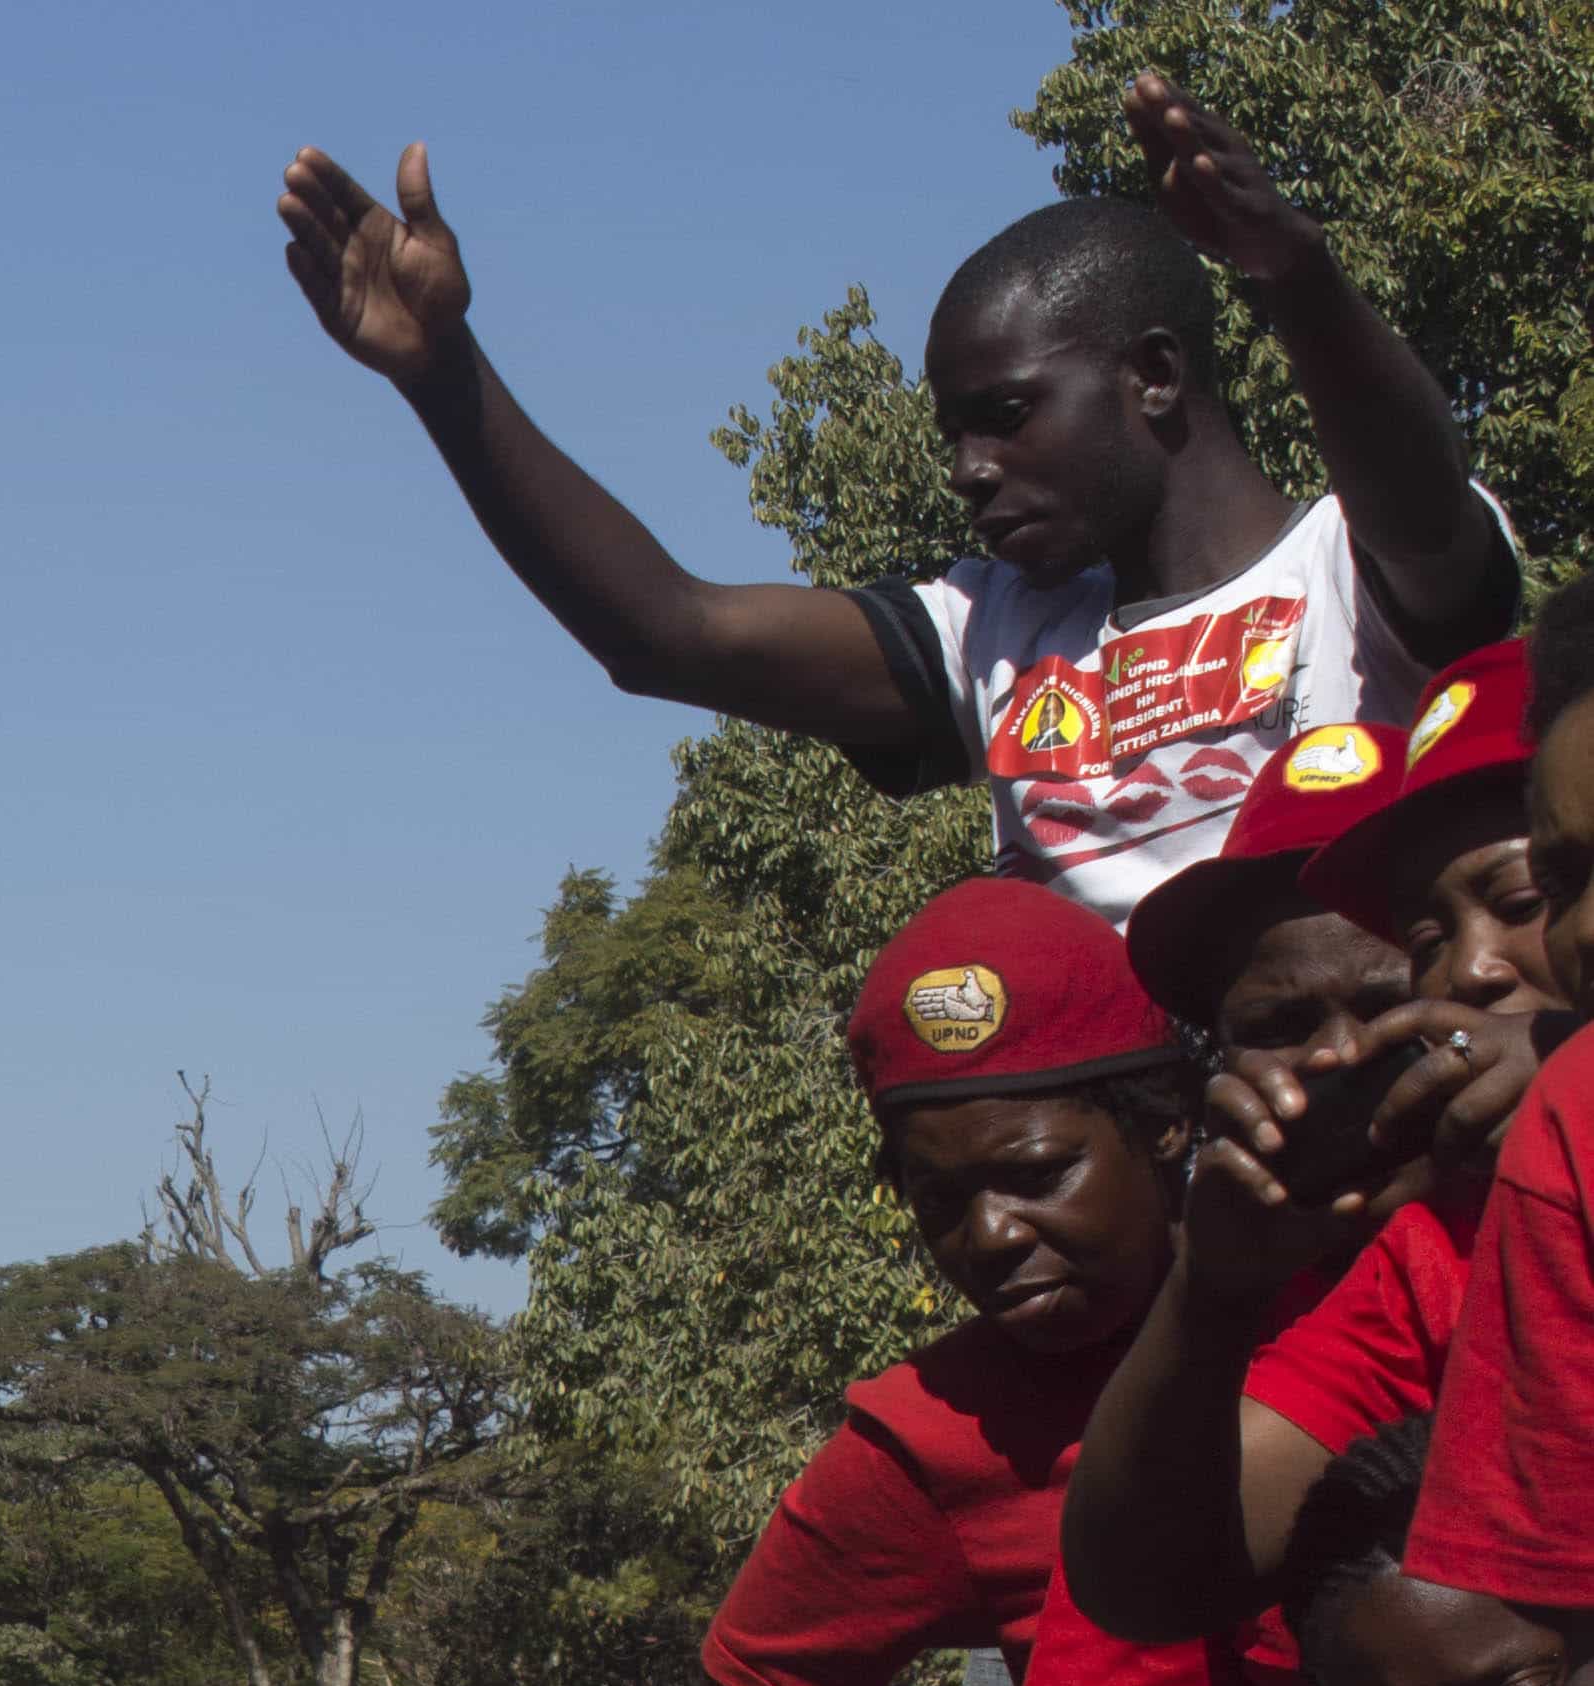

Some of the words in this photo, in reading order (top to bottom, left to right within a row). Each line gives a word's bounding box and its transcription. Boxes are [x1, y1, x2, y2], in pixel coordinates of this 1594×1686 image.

[1128, 659, 1169, 678] UPND
[1136, 691, 1155, 709] HH
[1113, 730, 1157, 757] ETTER
[1161, 709, 1222, 737] ZAMBIA
[932, 1026, 979, 1041] UPND
